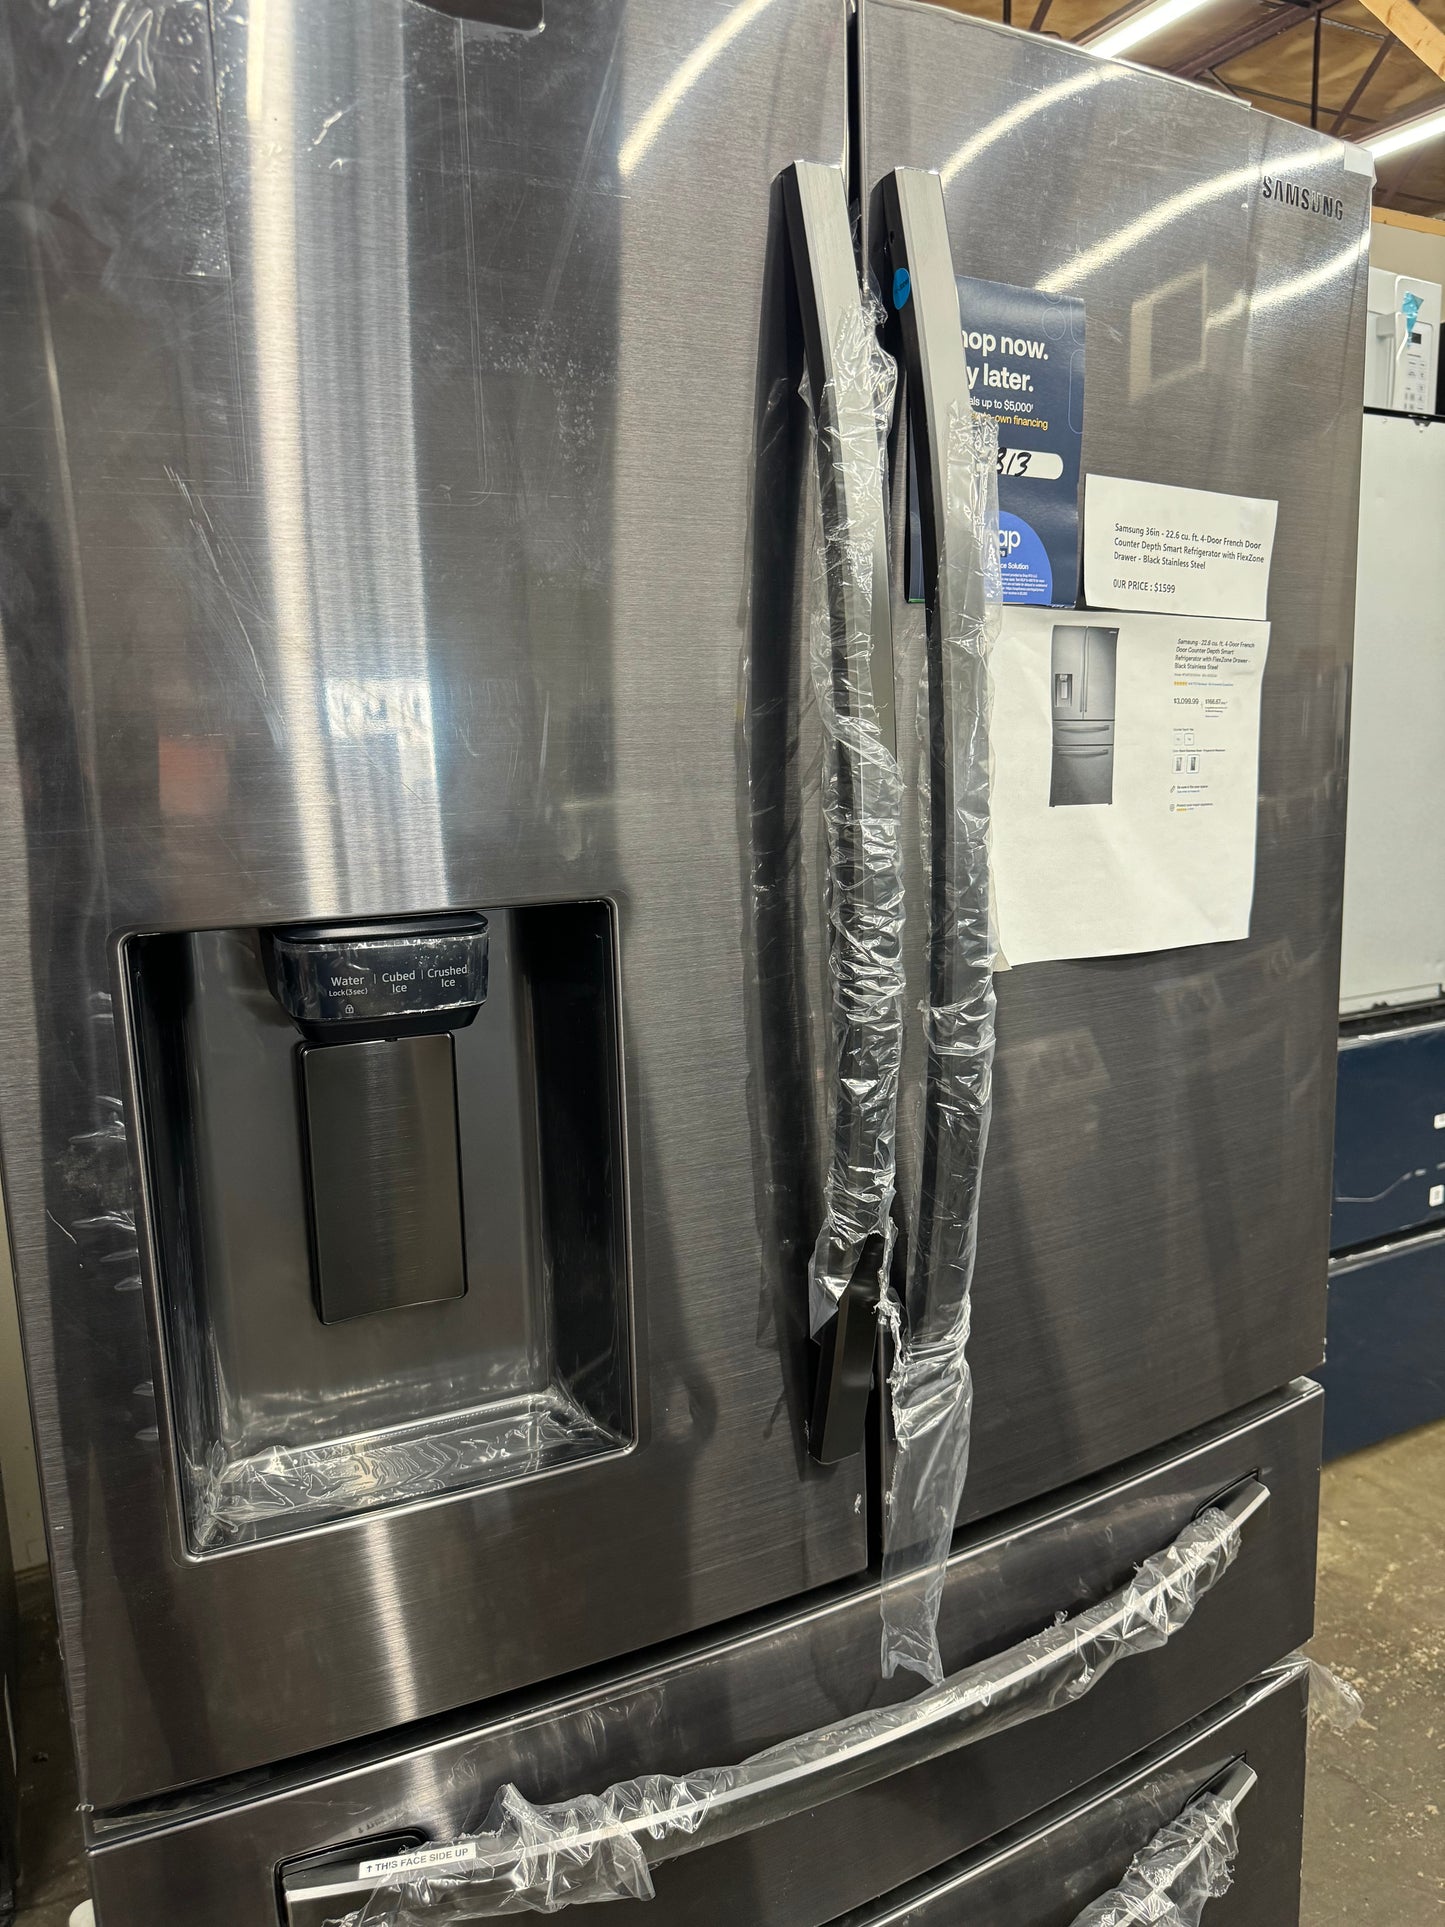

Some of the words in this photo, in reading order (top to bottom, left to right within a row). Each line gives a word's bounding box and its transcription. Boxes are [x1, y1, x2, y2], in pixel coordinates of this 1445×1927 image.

[1263, 175, 1343, 221] SAMSUNG
[1001, 336, 1049, 360] now.
[983, 363, 1034, 392] later.
[981, 400, 993, 410] up
[994, 399, 1003, 409] to
[1013, 414, 1049, 431] financing
[1114, 523, 1144, 537] Samsung
[1146, 527, 1160, 537] 36in
[1165, 530, 1180, 540] 22.6
[1181, 533, 1191, 541] cu.
[1191, 533, 1200, 542] ft.
[1200, 534, 1223, 545] 4-Door
[1223, 536, 1244, 548] French
[1244, 540, 1262, 550] Door
[1114, 537, 1141, 549] Counter
[1141, 541, 1162, 552] Depth
[1162, 543, 1183, 554] Smart
[1183, 545, 1221, 558] Refrigerator
[1221, 550, 1236, 560] with
[1236, 552, 1265, 564] FlexZone
[1007, 561, 1030, 570] Solution
[1114, 551, 1137, 562] Drawer
[1142, 554, 1161, 565] Black
[1161, 556, 1190, 568] Stainless
[1190, 559, 1206, 570] Steel
[1112, 578, 1127, 589] OUR
[1127, 580, 1149, 591] PRICE
[1154, 582, 1176, 594] $1599
[1177, 638, 1198, 646] Samsung
[1175, 654, 1202, 662] Refrigerator
[331, 976, 365, 987] Water
[382, 970, 416, 983] Cubed
[427, 964, 467, 978] Crushed
[392, 983, 408, 993] Ice
[441, 979, 456, 988] Ice
[375, 1860, 398, 1871] THIS
[400, 1855, 427, 1866] FACE
[429, 1851, 452, 1862] SIDE
[455, 1847, 469, 1857] UP
